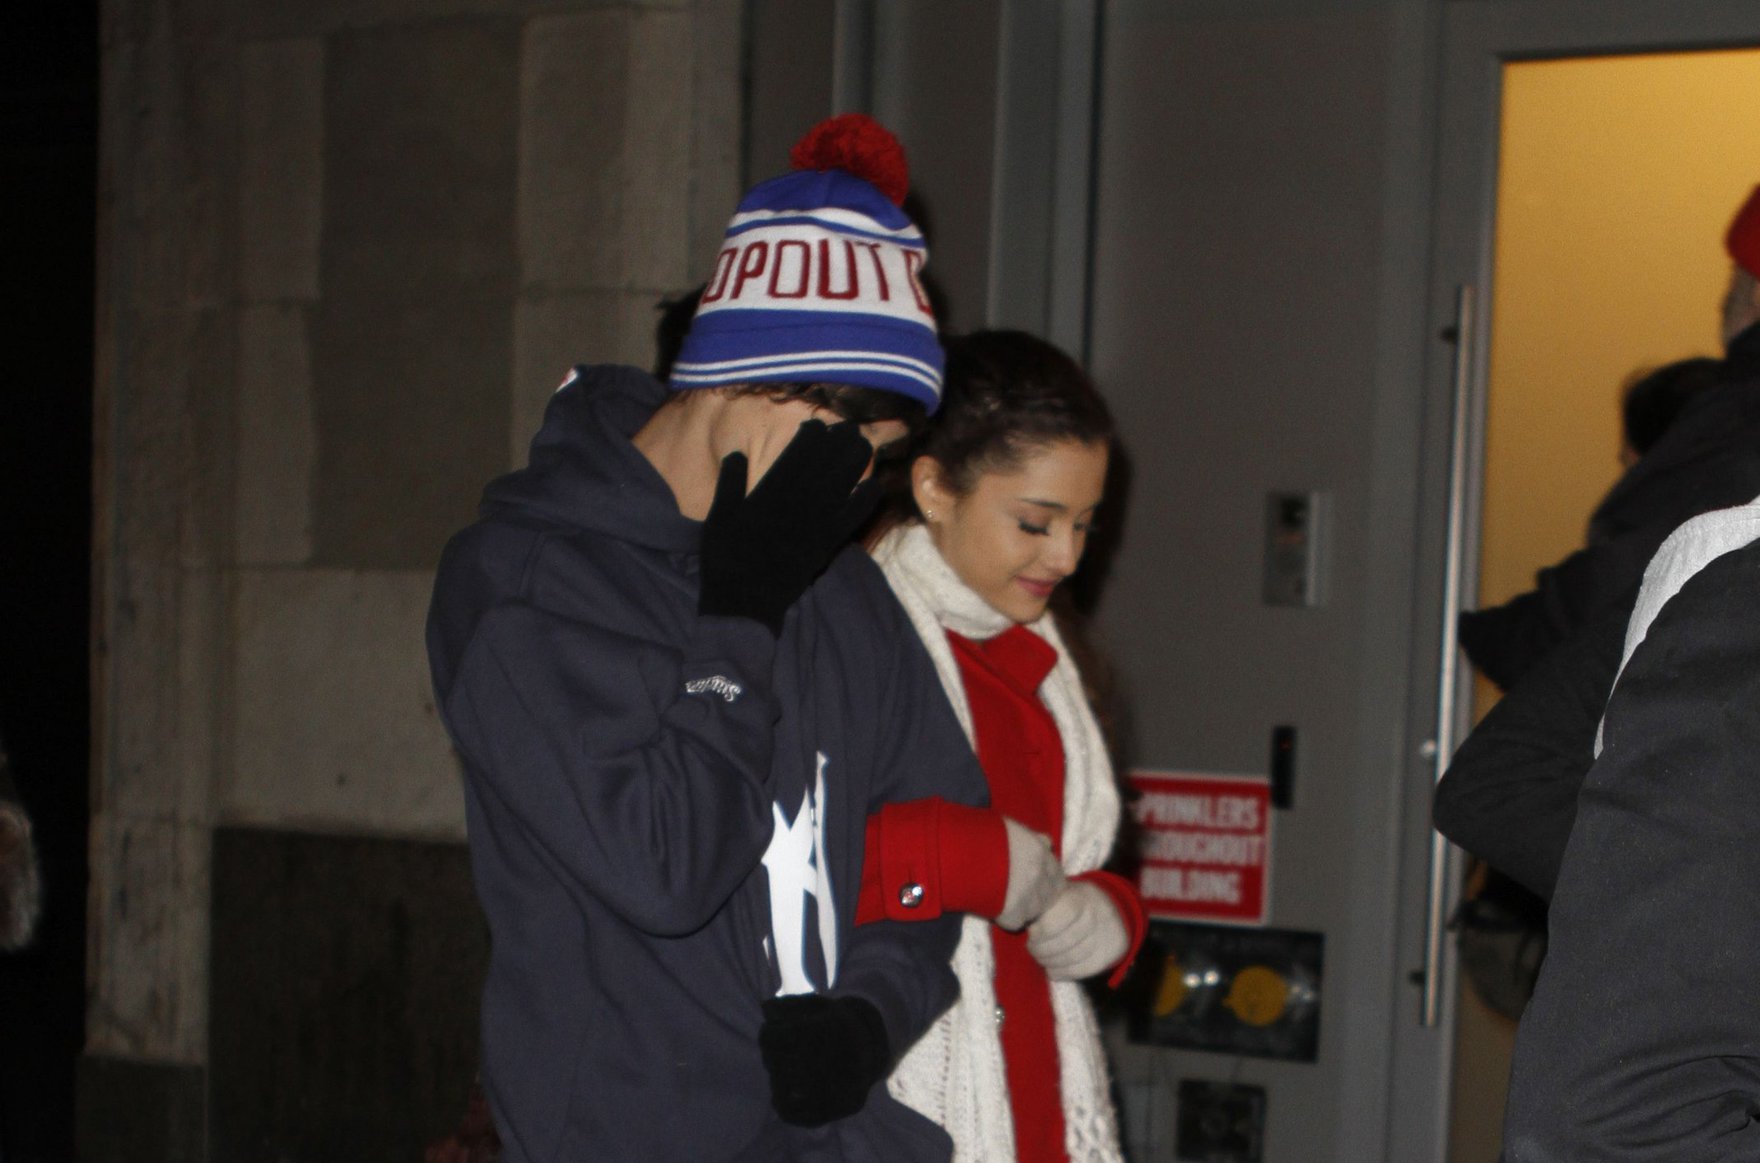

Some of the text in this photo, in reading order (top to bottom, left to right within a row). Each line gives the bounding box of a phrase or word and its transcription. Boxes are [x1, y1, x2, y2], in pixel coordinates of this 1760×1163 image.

[1130, 792, 1259, 829] PRINKLERS
[1143, 830, 1264, 866] ROUGHOUT
[1140, 865, 1242, 905] BUILDING
